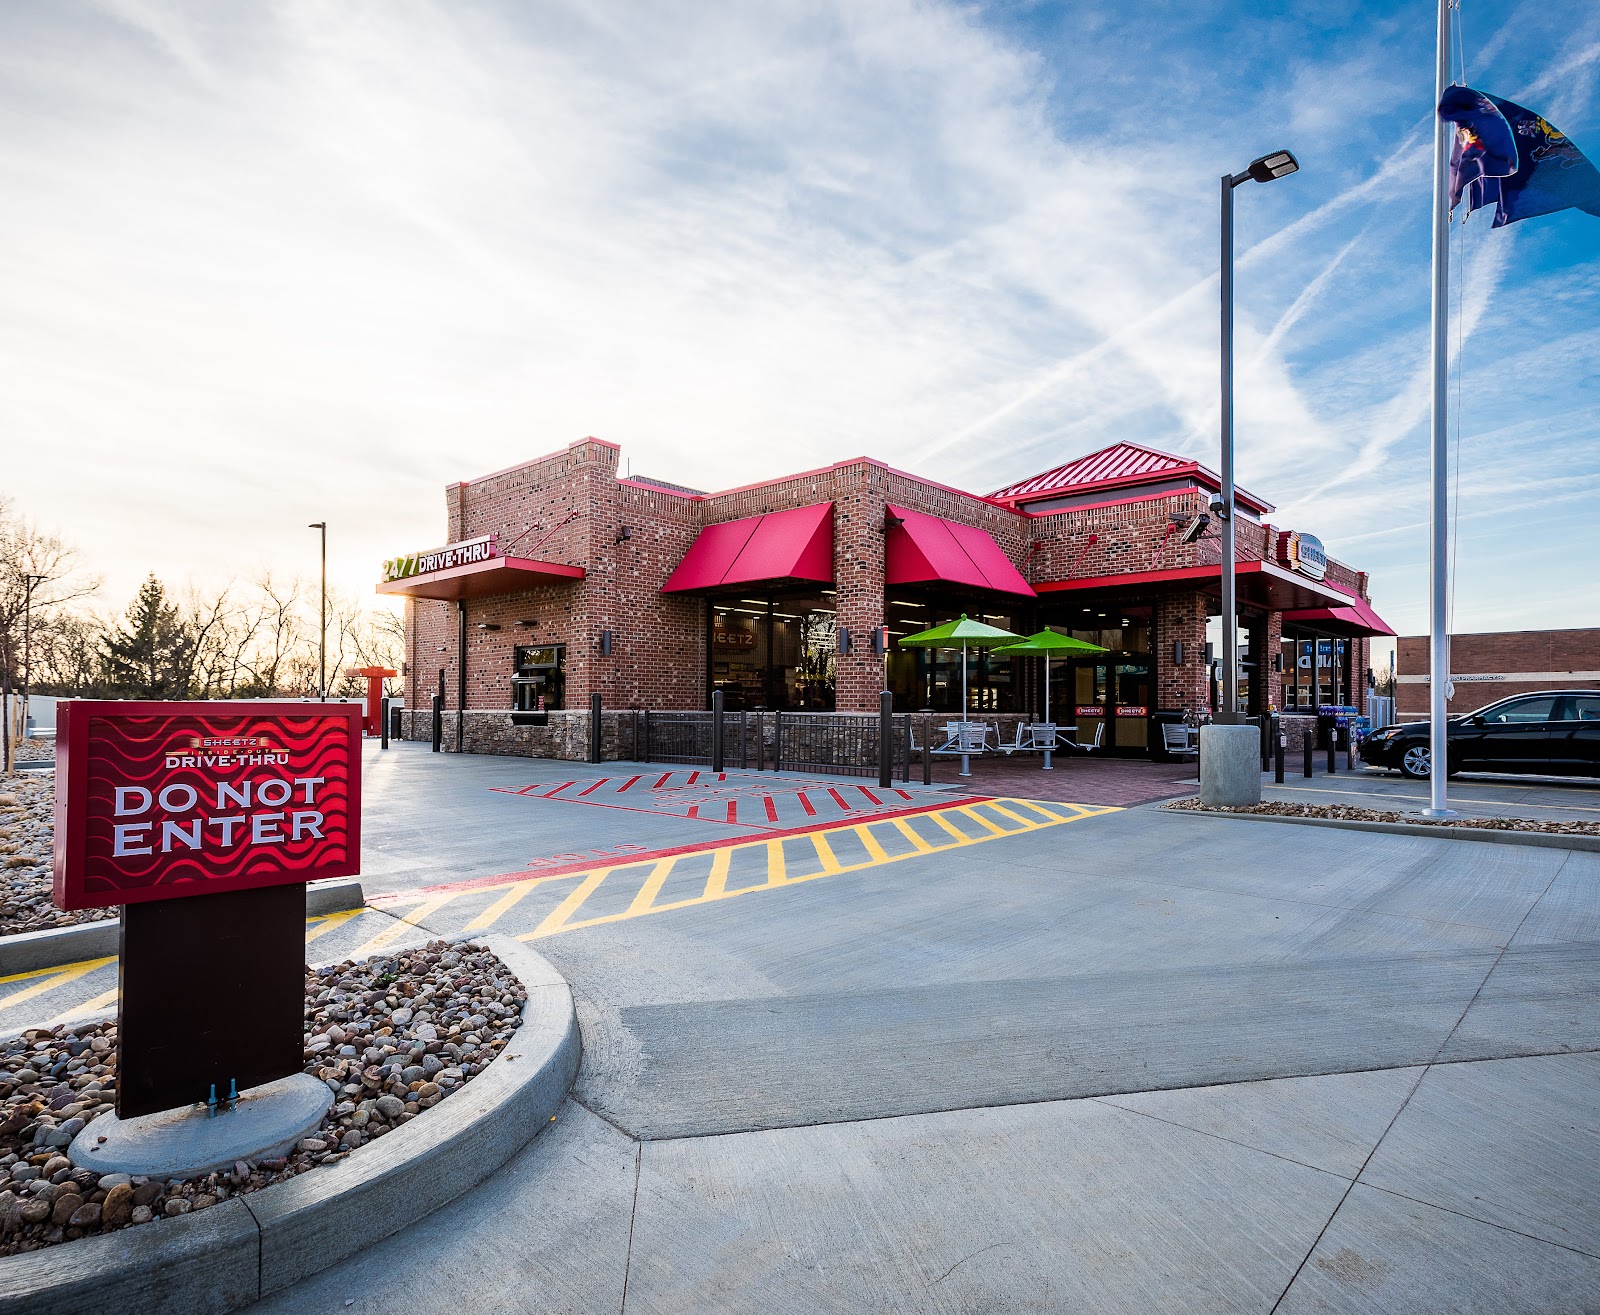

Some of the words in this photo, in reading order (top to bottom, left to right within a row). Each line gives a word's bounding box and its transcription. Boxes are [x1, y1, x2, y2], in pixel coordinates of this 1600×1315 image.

[381, 551, 420, 582] 24/7
[418, 541, 491, 572] DRIVE-THRU
[165, 754, 289, 769] DRIVE-THRU
[203, 738, 257, 746] SHEETZ
[113, 783, 198, 816] DO
[216, 776, 325, 809] NOT
[112, 811, 325, 857] ENTER
